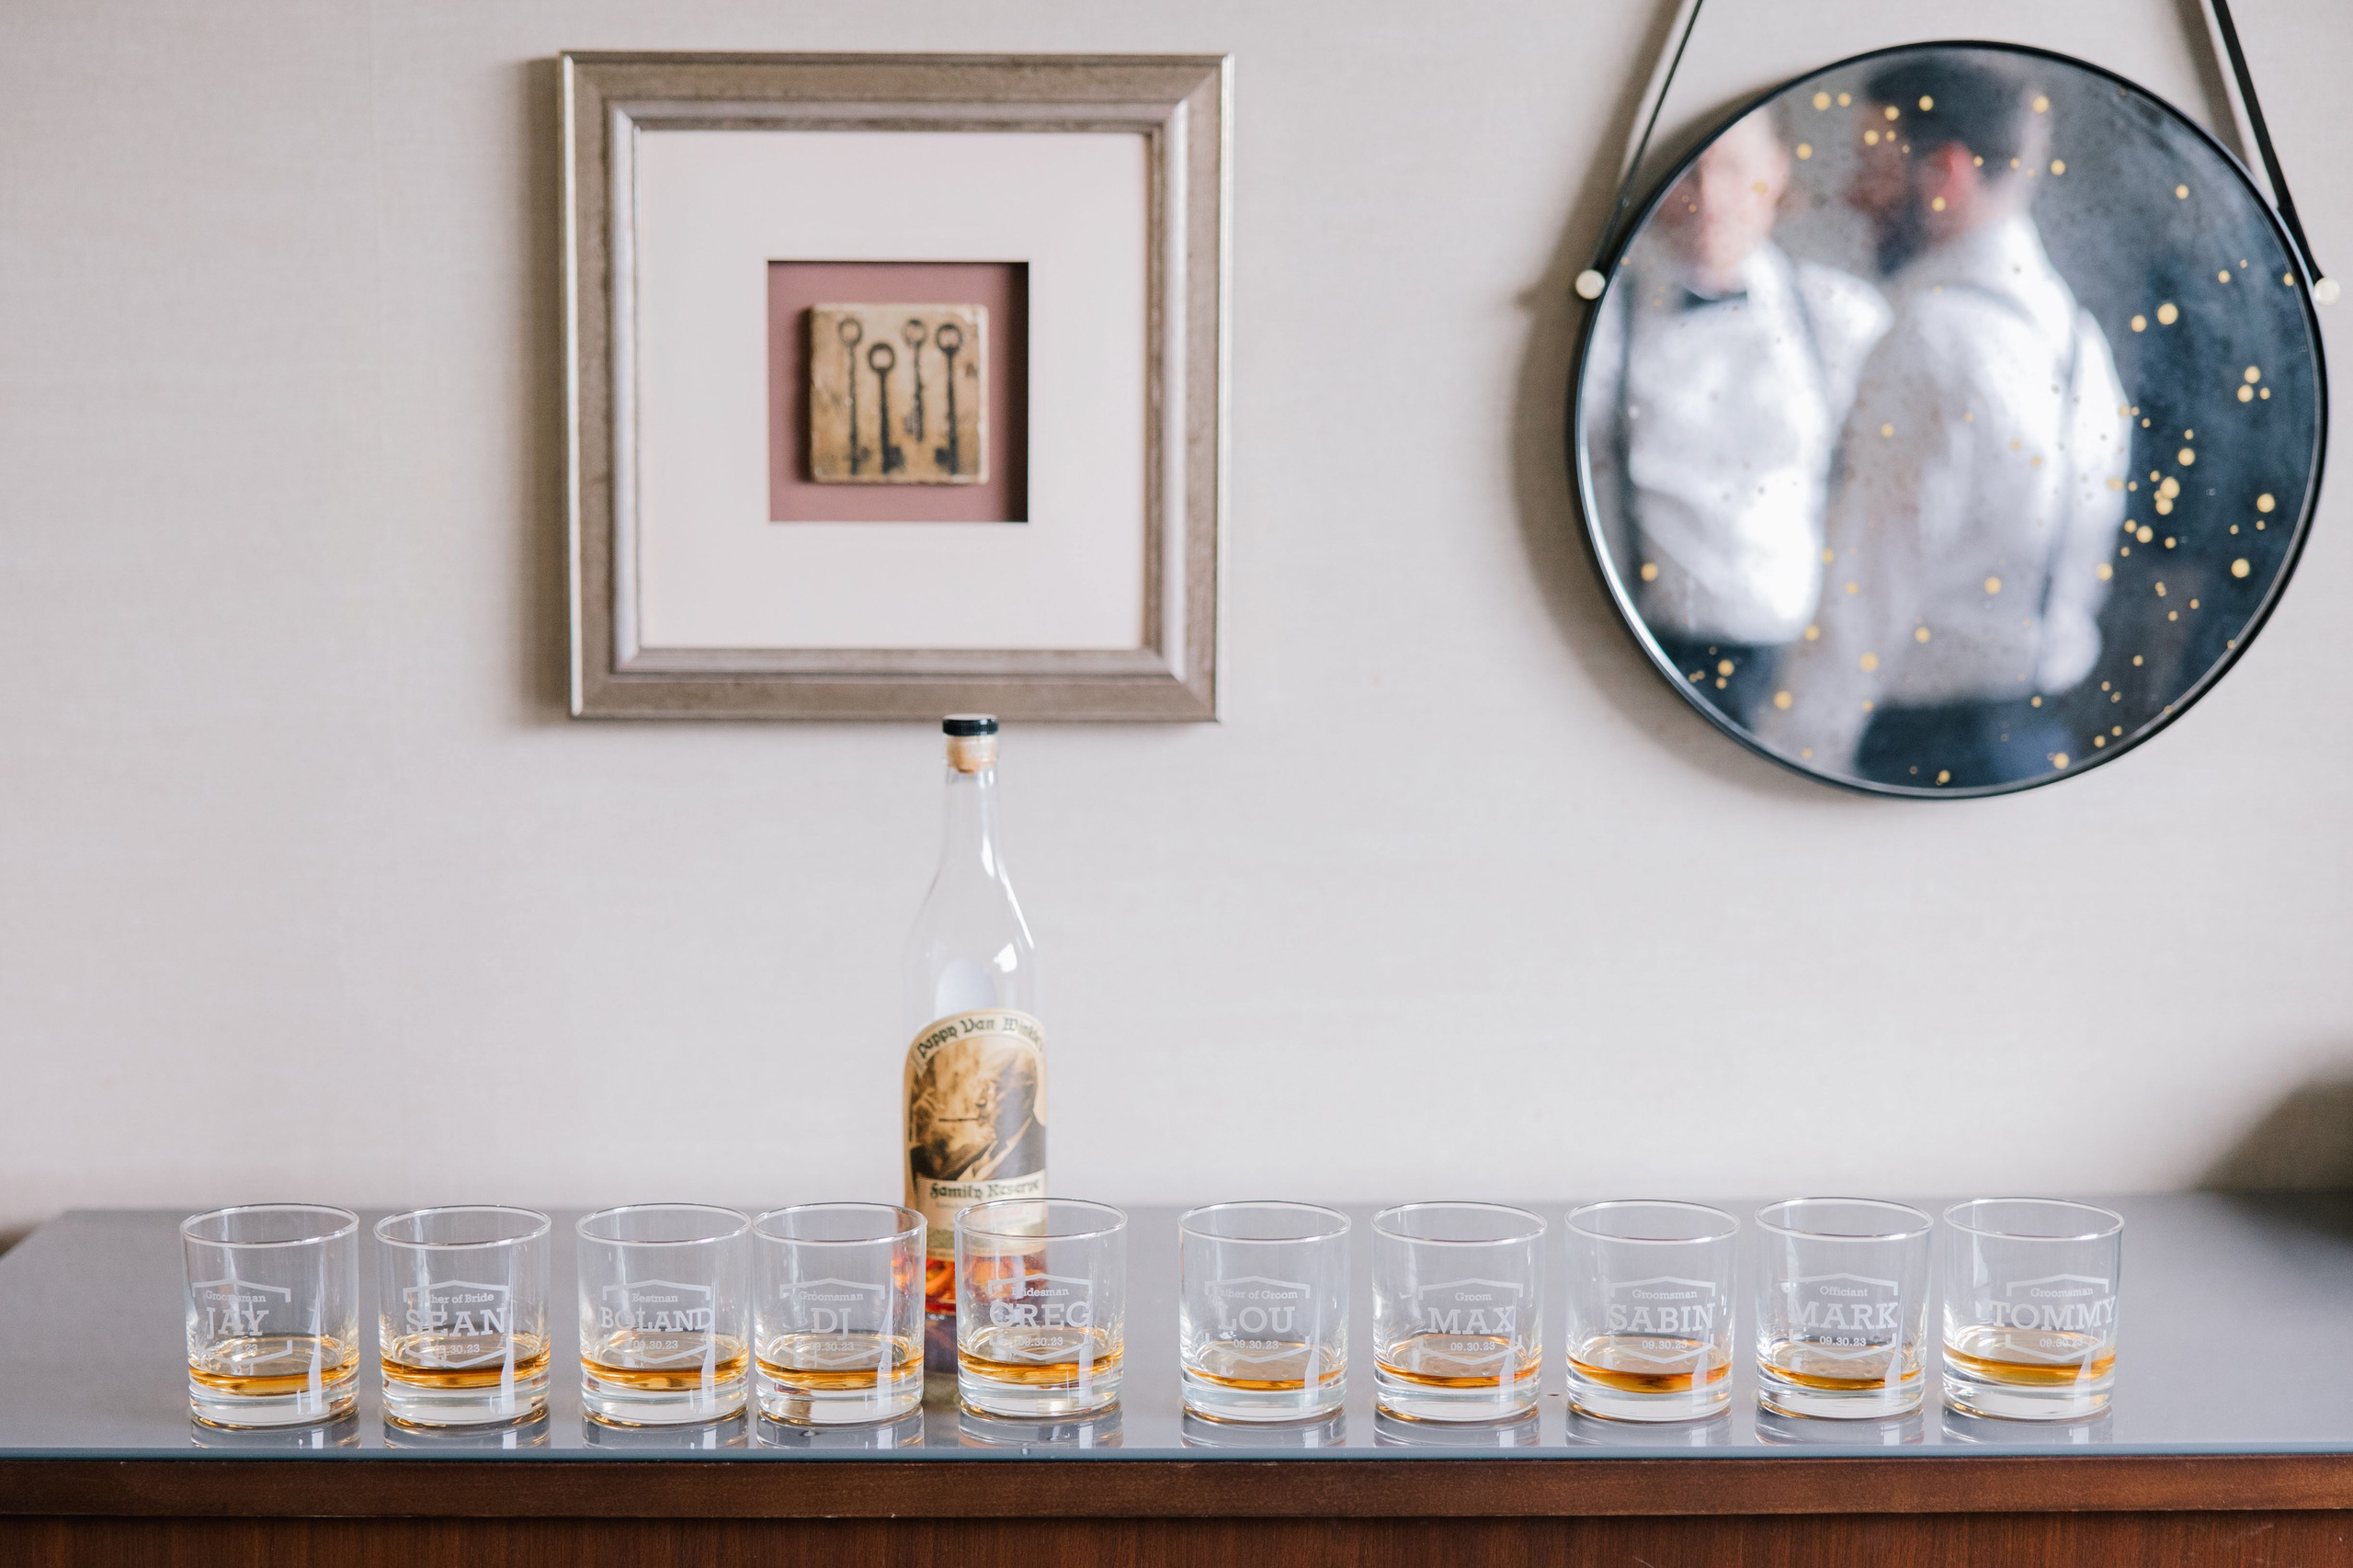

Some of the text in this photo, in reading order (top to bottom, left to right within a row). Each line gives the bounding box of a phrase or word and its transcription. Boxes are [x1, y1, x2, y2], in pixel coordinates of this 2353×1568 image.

[916, 1024, 959, 1059] Pappy
[960, 1017, 995, 1033] Van
[929, 1182, 983, 1199] Family
[451, 1293, 464, 1304] of
[464, 1292, 494, 1303] Bride
[631, 1292, 679, 1303] Bestman
[798, 1290, 864, 1302] Groomsman
[1248, 1290, 1260, 1300] of
[1260, 1290, 1299, 1300] Groom
[1454, 1291, 1493, 1301] Groom
[1631, 1289, 1698, 1300] Groomsman
[1819, 1286, 1869, 1298] Officiant
[2029, 1287, 2094, 1298] Groomsman
[989, 1301, 1091, 1329] GREG
[1215, 1304, 1296, 1334] LOU
[1608, 1302, 1716, 1334] SABIN
[1789, 1298, 1899, 1330] MARK
[1988, 1295, 2117, 1331] TOMMY
[206, 1307, 269, 1340] JAY
[405, 1306, 507, 1337] SEAN
[600, 1306, 715, 1333] BOLAND
[810, 1307, 852, 1341] DJ
[1427, 1305, 1516, 1335] MAX
[632, 1339, 679, 1350] 09.30.23
[809, 1341, 855, 1352] 09.30.23
[1233, 1338, 1279, 1350] 09.30.23
[1449, 1341, 1496, 1352] 09.30.23
[1642, 1339, 1688, 1350] 09.30.23
[1819, 1335, 1868, 1347] 09.30.23
[2039, 1337, 2085, 1348] 09.30.23
[434, 1343, 481, 1355] 9.30.23
